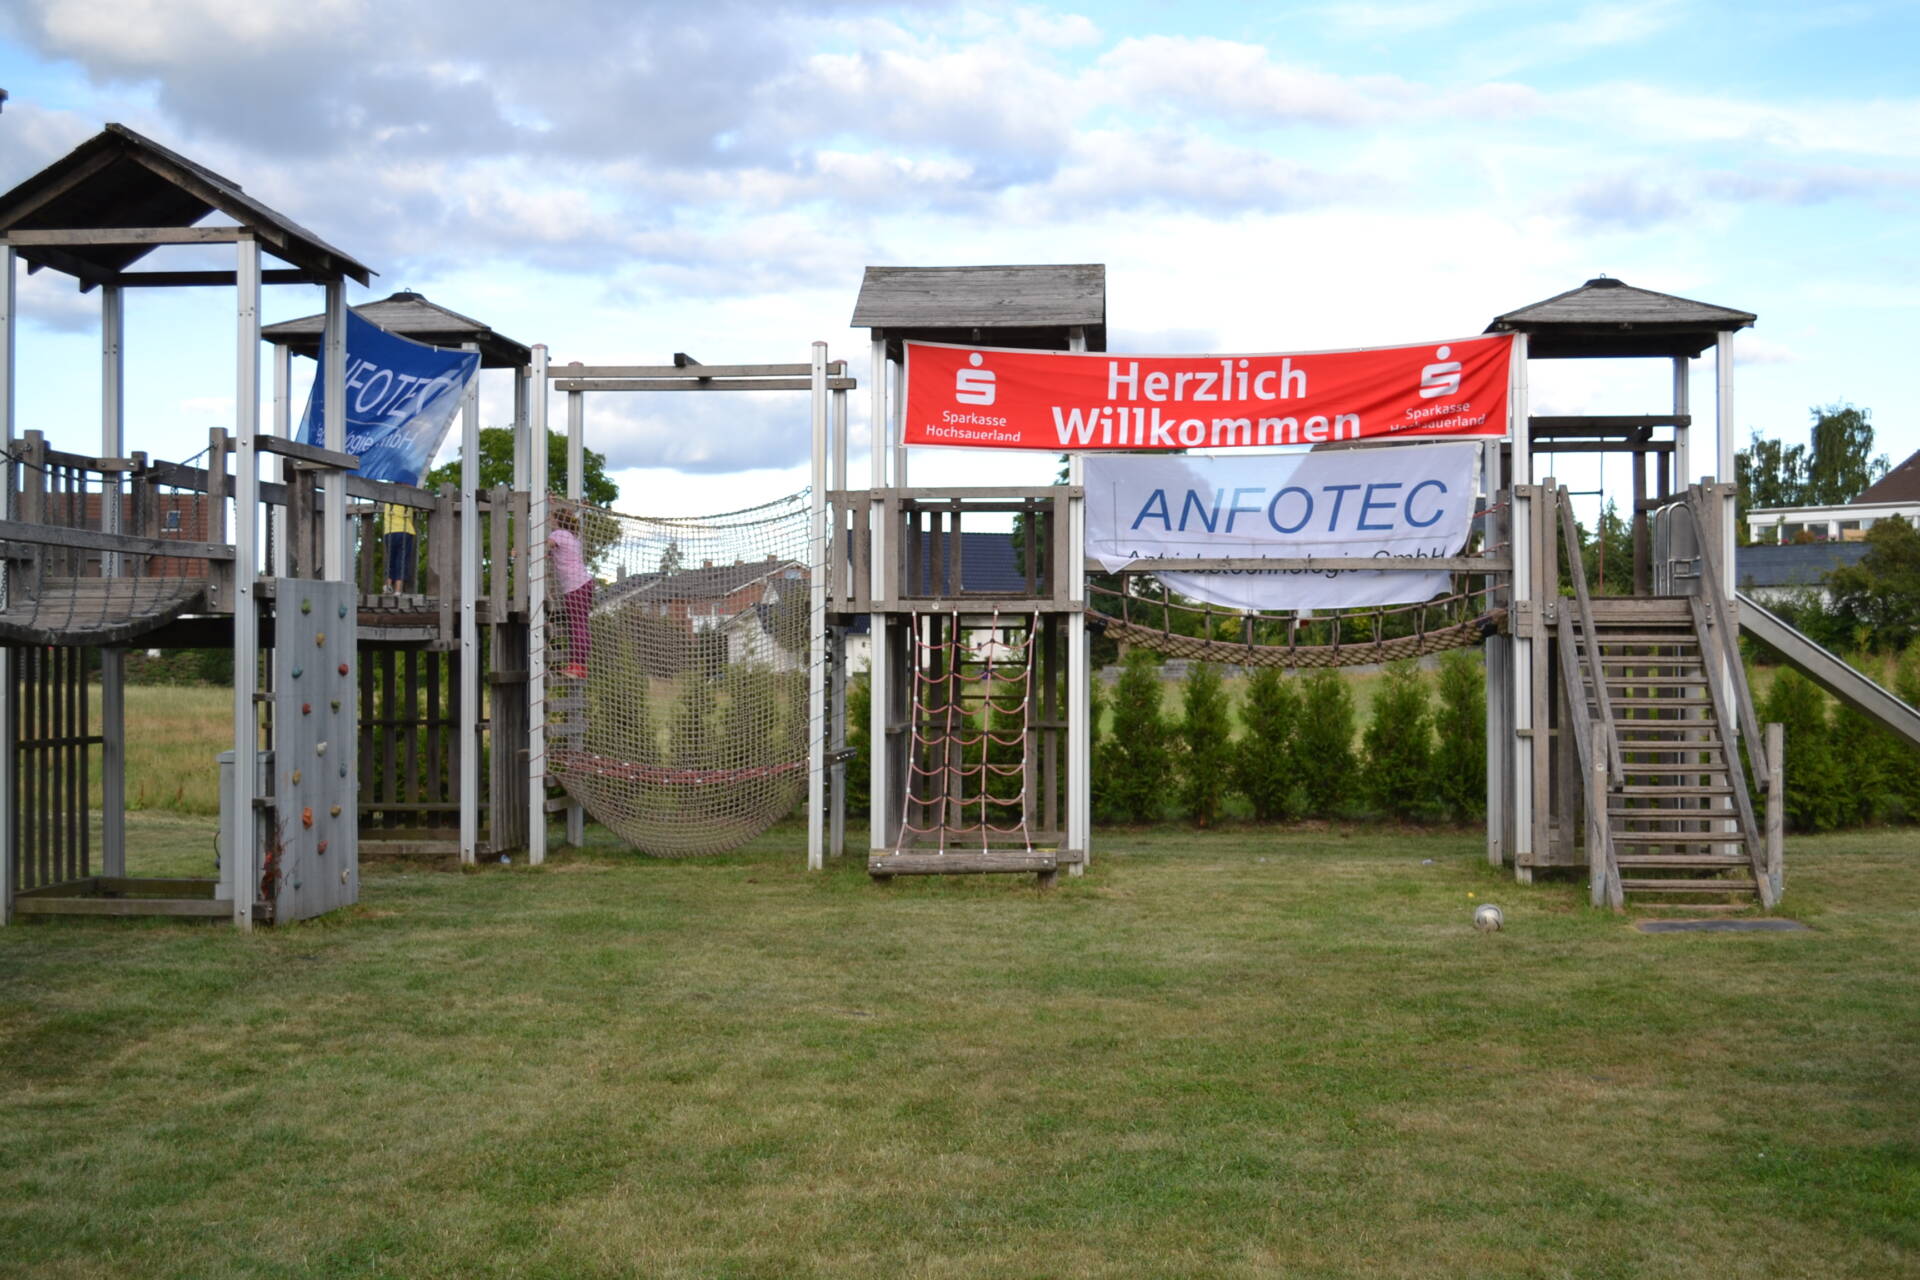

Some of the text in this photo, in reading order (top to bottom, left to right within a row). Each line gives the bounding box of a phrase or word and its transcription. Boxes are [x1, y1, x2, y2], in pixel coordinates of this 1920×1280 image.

[1107, 358, 1307, 402] Herzlich
[942, 410, 1007, 427] Sparkasse
[1405, 402, 1471, 420] Sparkasse
[926, 424, 1021, 442] Hochsauerland
[1051, 406, 1361, 447] Willkommen
[1130, 479, 1448, 534] ANFOTEC
